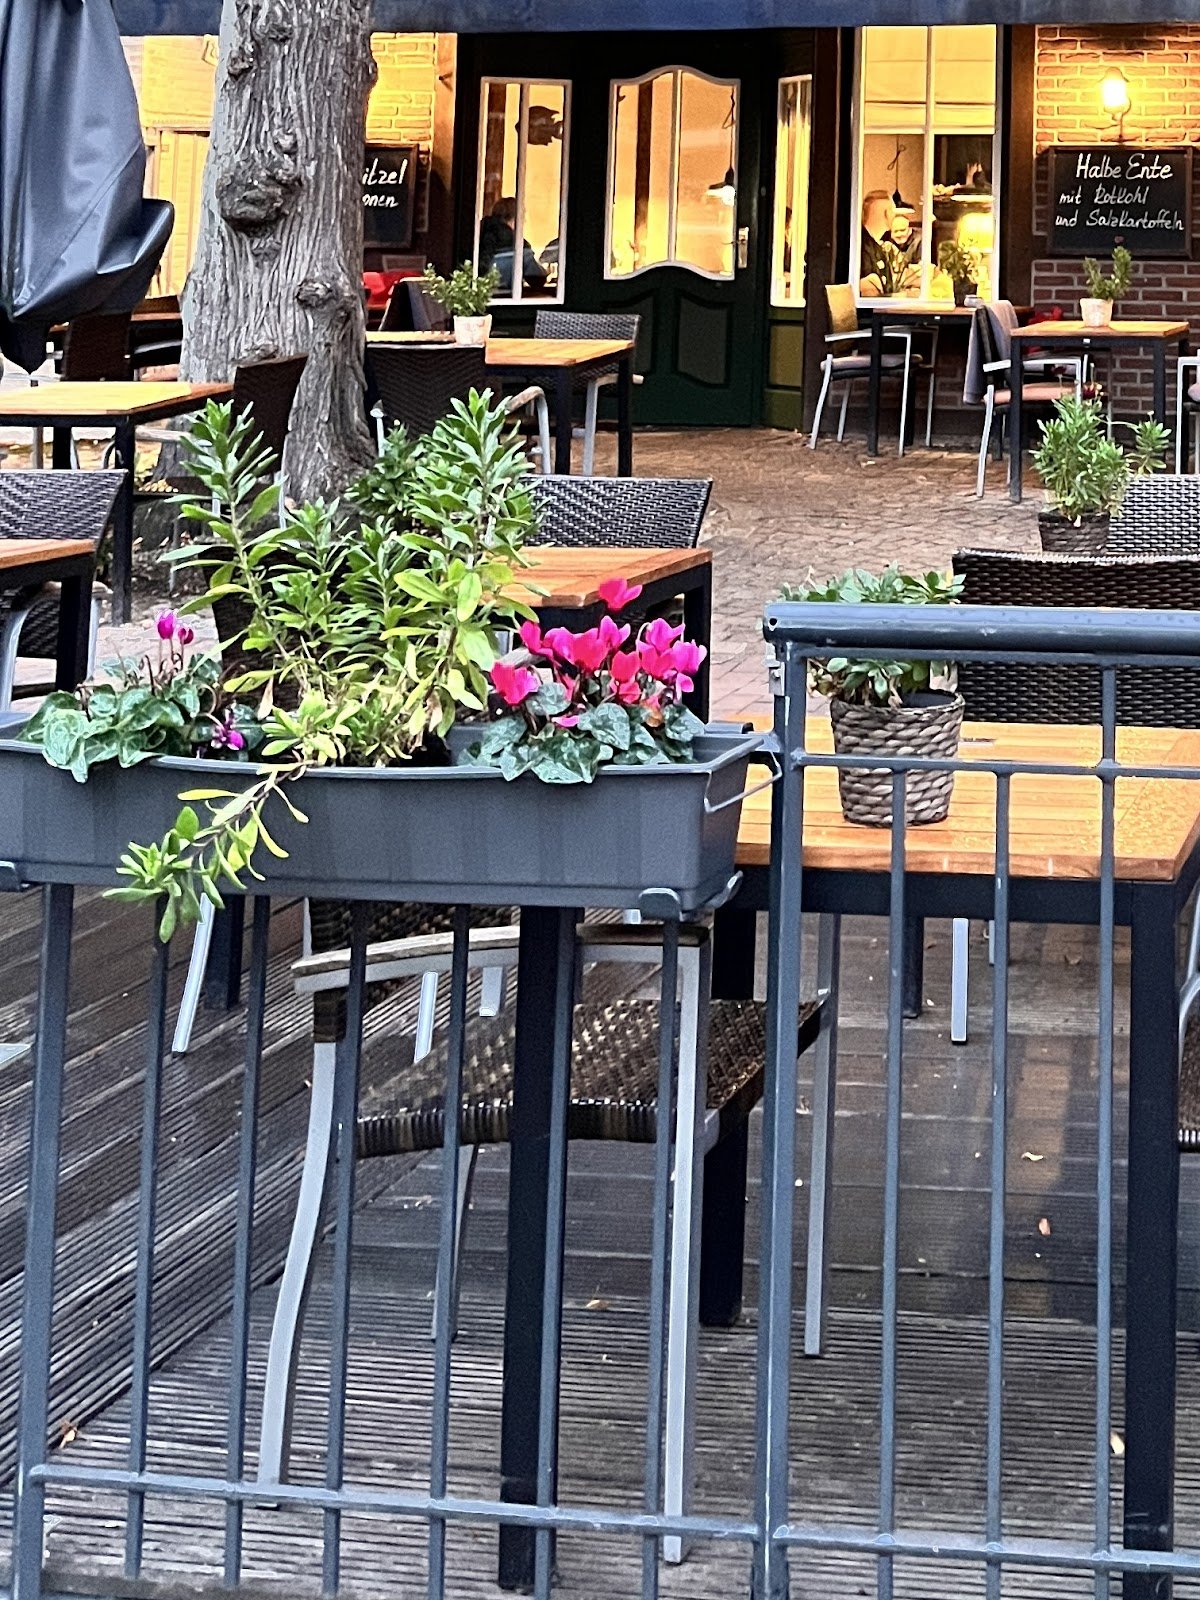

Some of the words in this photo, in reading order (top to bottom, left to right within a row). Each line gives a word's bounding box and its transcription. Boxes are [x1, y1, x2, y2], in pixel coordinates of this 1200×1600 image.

[362, 158, 408, 186] itzel
[1075, 153, 1122, 180] Halbe
[1125, 153, 1173, 180] Ente
[362, 193, 399, 208] onen
[1059, 185, 1082, 204] mit
[1055, 209, 1079, 227] und
